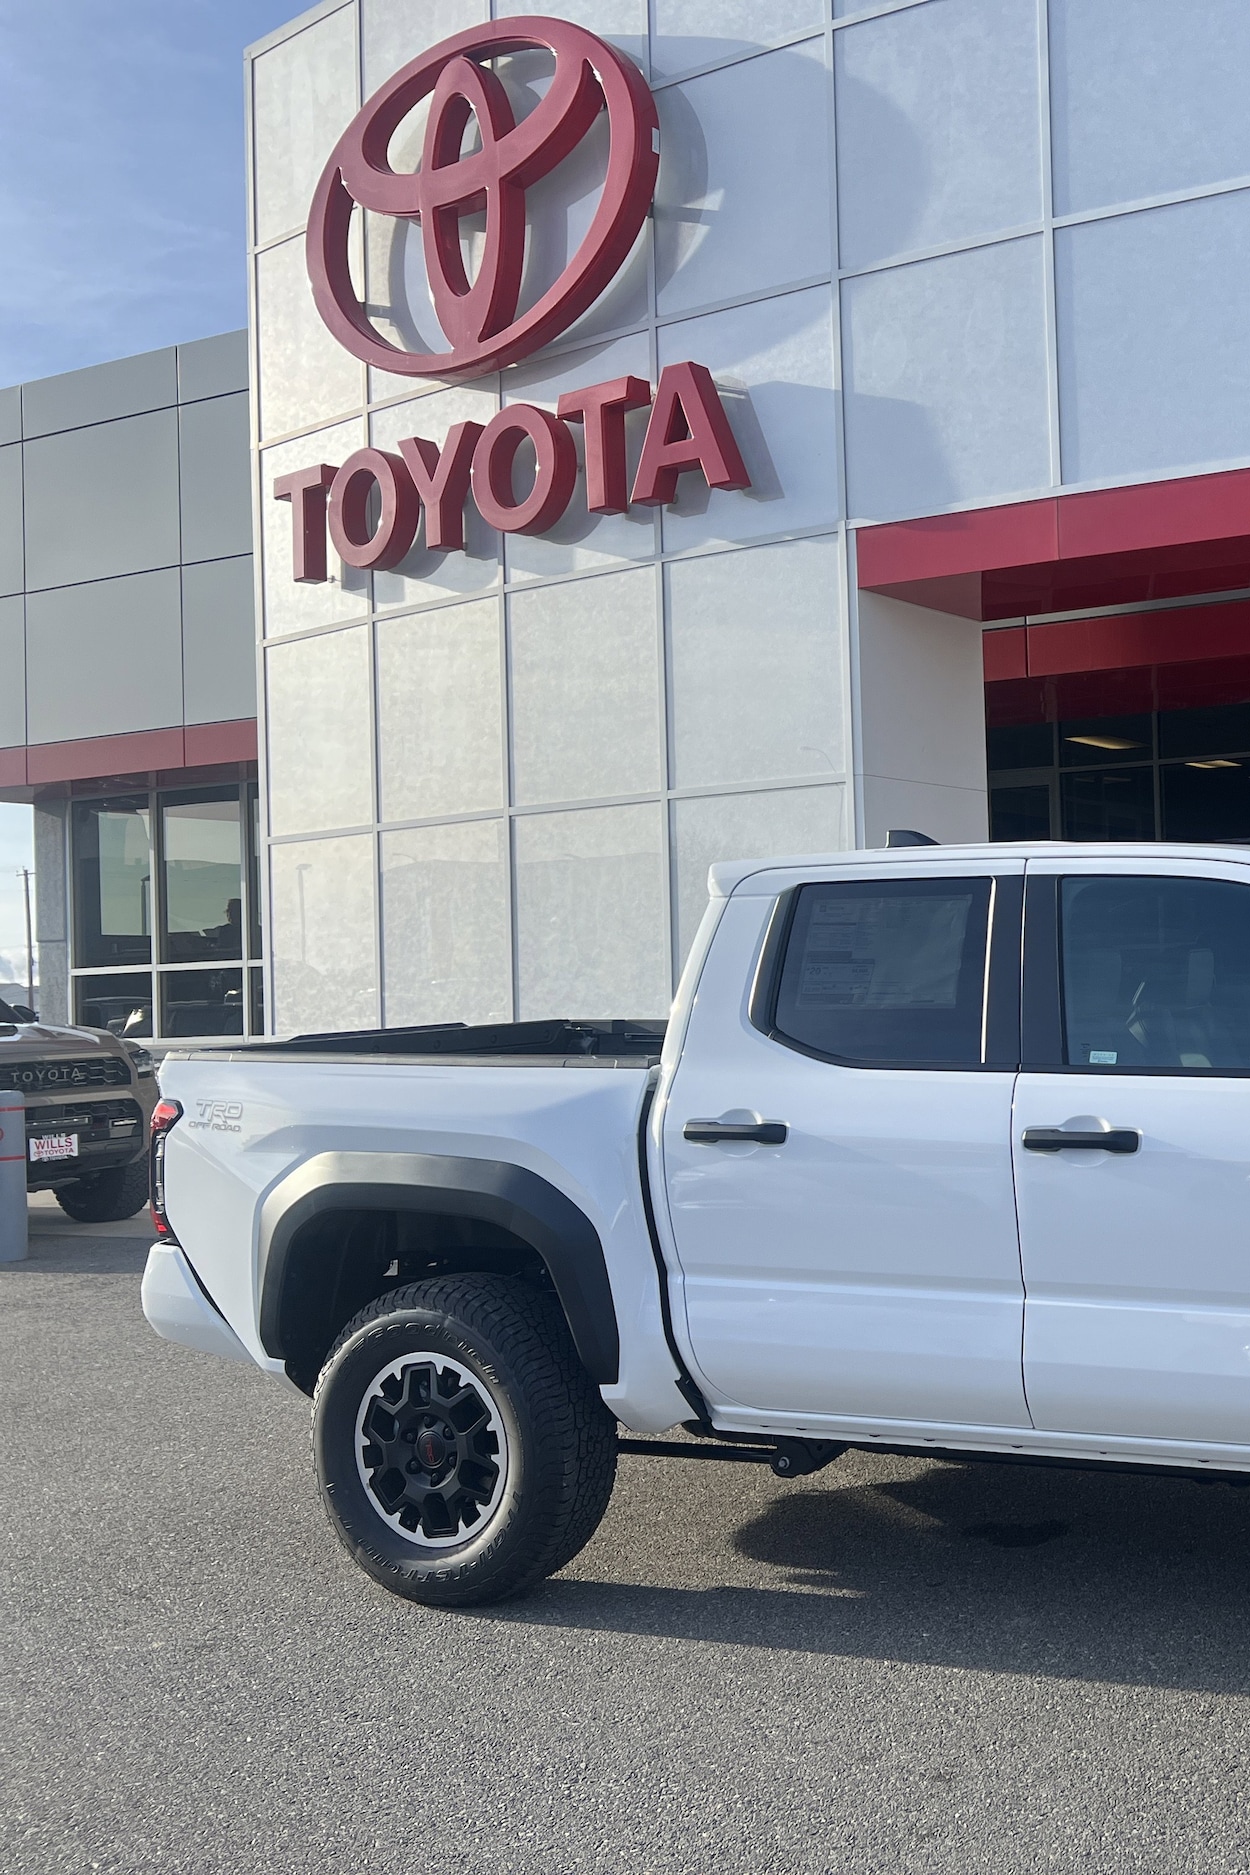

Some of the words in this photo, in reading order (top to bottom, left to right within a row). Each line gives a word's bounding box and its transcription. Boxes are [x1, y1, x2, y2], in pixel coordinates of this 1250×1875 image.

[274, 361, 752, 584] TOYOTA
[11, 1067, 80, 1083] TOYOTA
[196, 1099, 243, 1124] TRD
[211, 1123, 241, 1132] ROAD
[34, 1137, 73, 1149] WILLS
